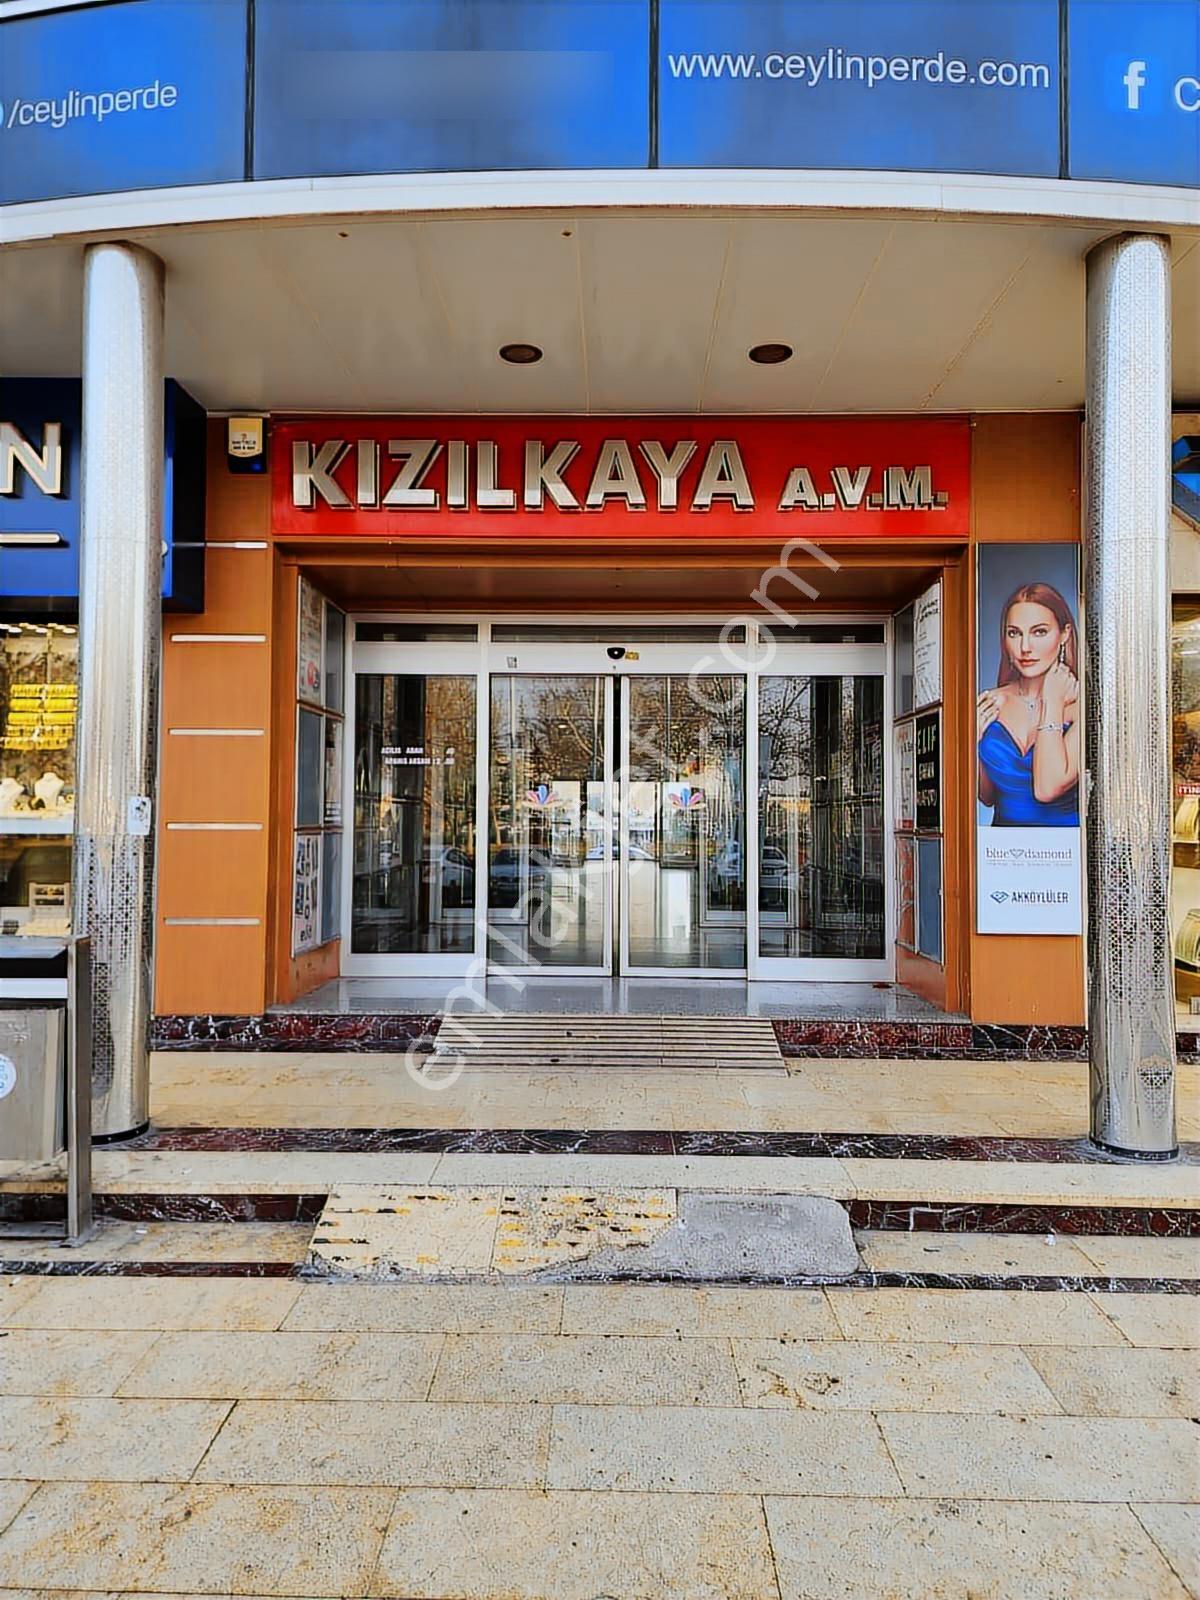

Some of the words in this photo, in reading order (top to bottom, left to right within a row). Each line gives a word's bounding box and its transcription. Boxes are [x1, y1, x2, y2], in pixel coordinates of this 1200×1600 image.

[668, 48, 1051, 89] www.ceylinperde.com
[6, 79, 178, 129] /ceylinperde
[291, 439, 756, 512] KIZILKAYA
[778, 465, 949, 512] A.V.M.
